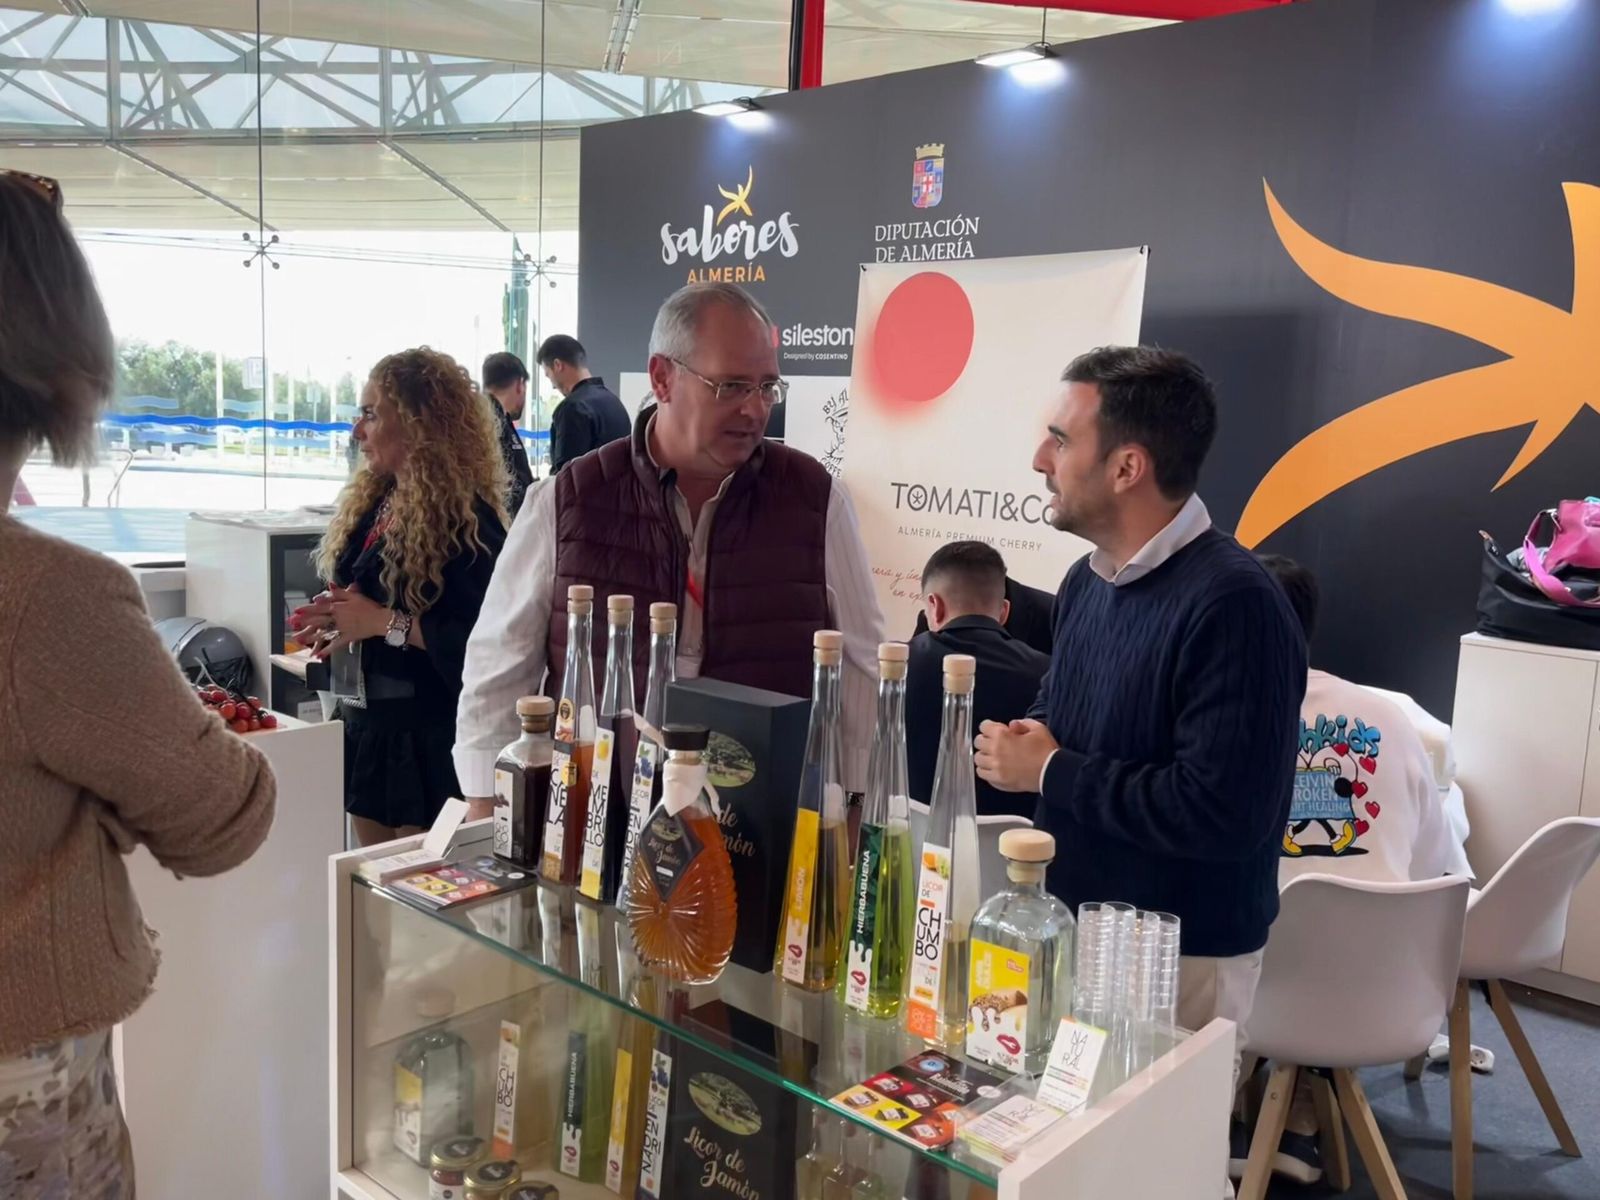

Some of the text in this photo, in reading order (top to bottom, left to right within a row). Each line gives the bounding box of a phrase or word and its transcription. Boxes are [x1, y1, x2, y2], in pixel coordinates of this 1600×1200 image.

[660, 205, 800, 265] sabores
[875, 214, 980, 242] DIPUTACIÓN
[875, 237, 975, 264] DE ALMERÍA
[687, 262, 766, 285] ALMERÍA
[782, 322, 854, 346] sileston
[815, 353, 848, 361] COSENTINO
[821, 457, 842, 478] COFFE
[898, 525, 1042, 552] ALMERÍA PREMIUM CHERRY
[1293, 787, 1338, 802] ROKEN
[856, 849, 871, 935] HIERBABUENA
[567, 1052, 578, 1118] HIERBABUENA
[725, 1148, 746, 1173] de
[700, 1160, 760, 1200] Jamón
